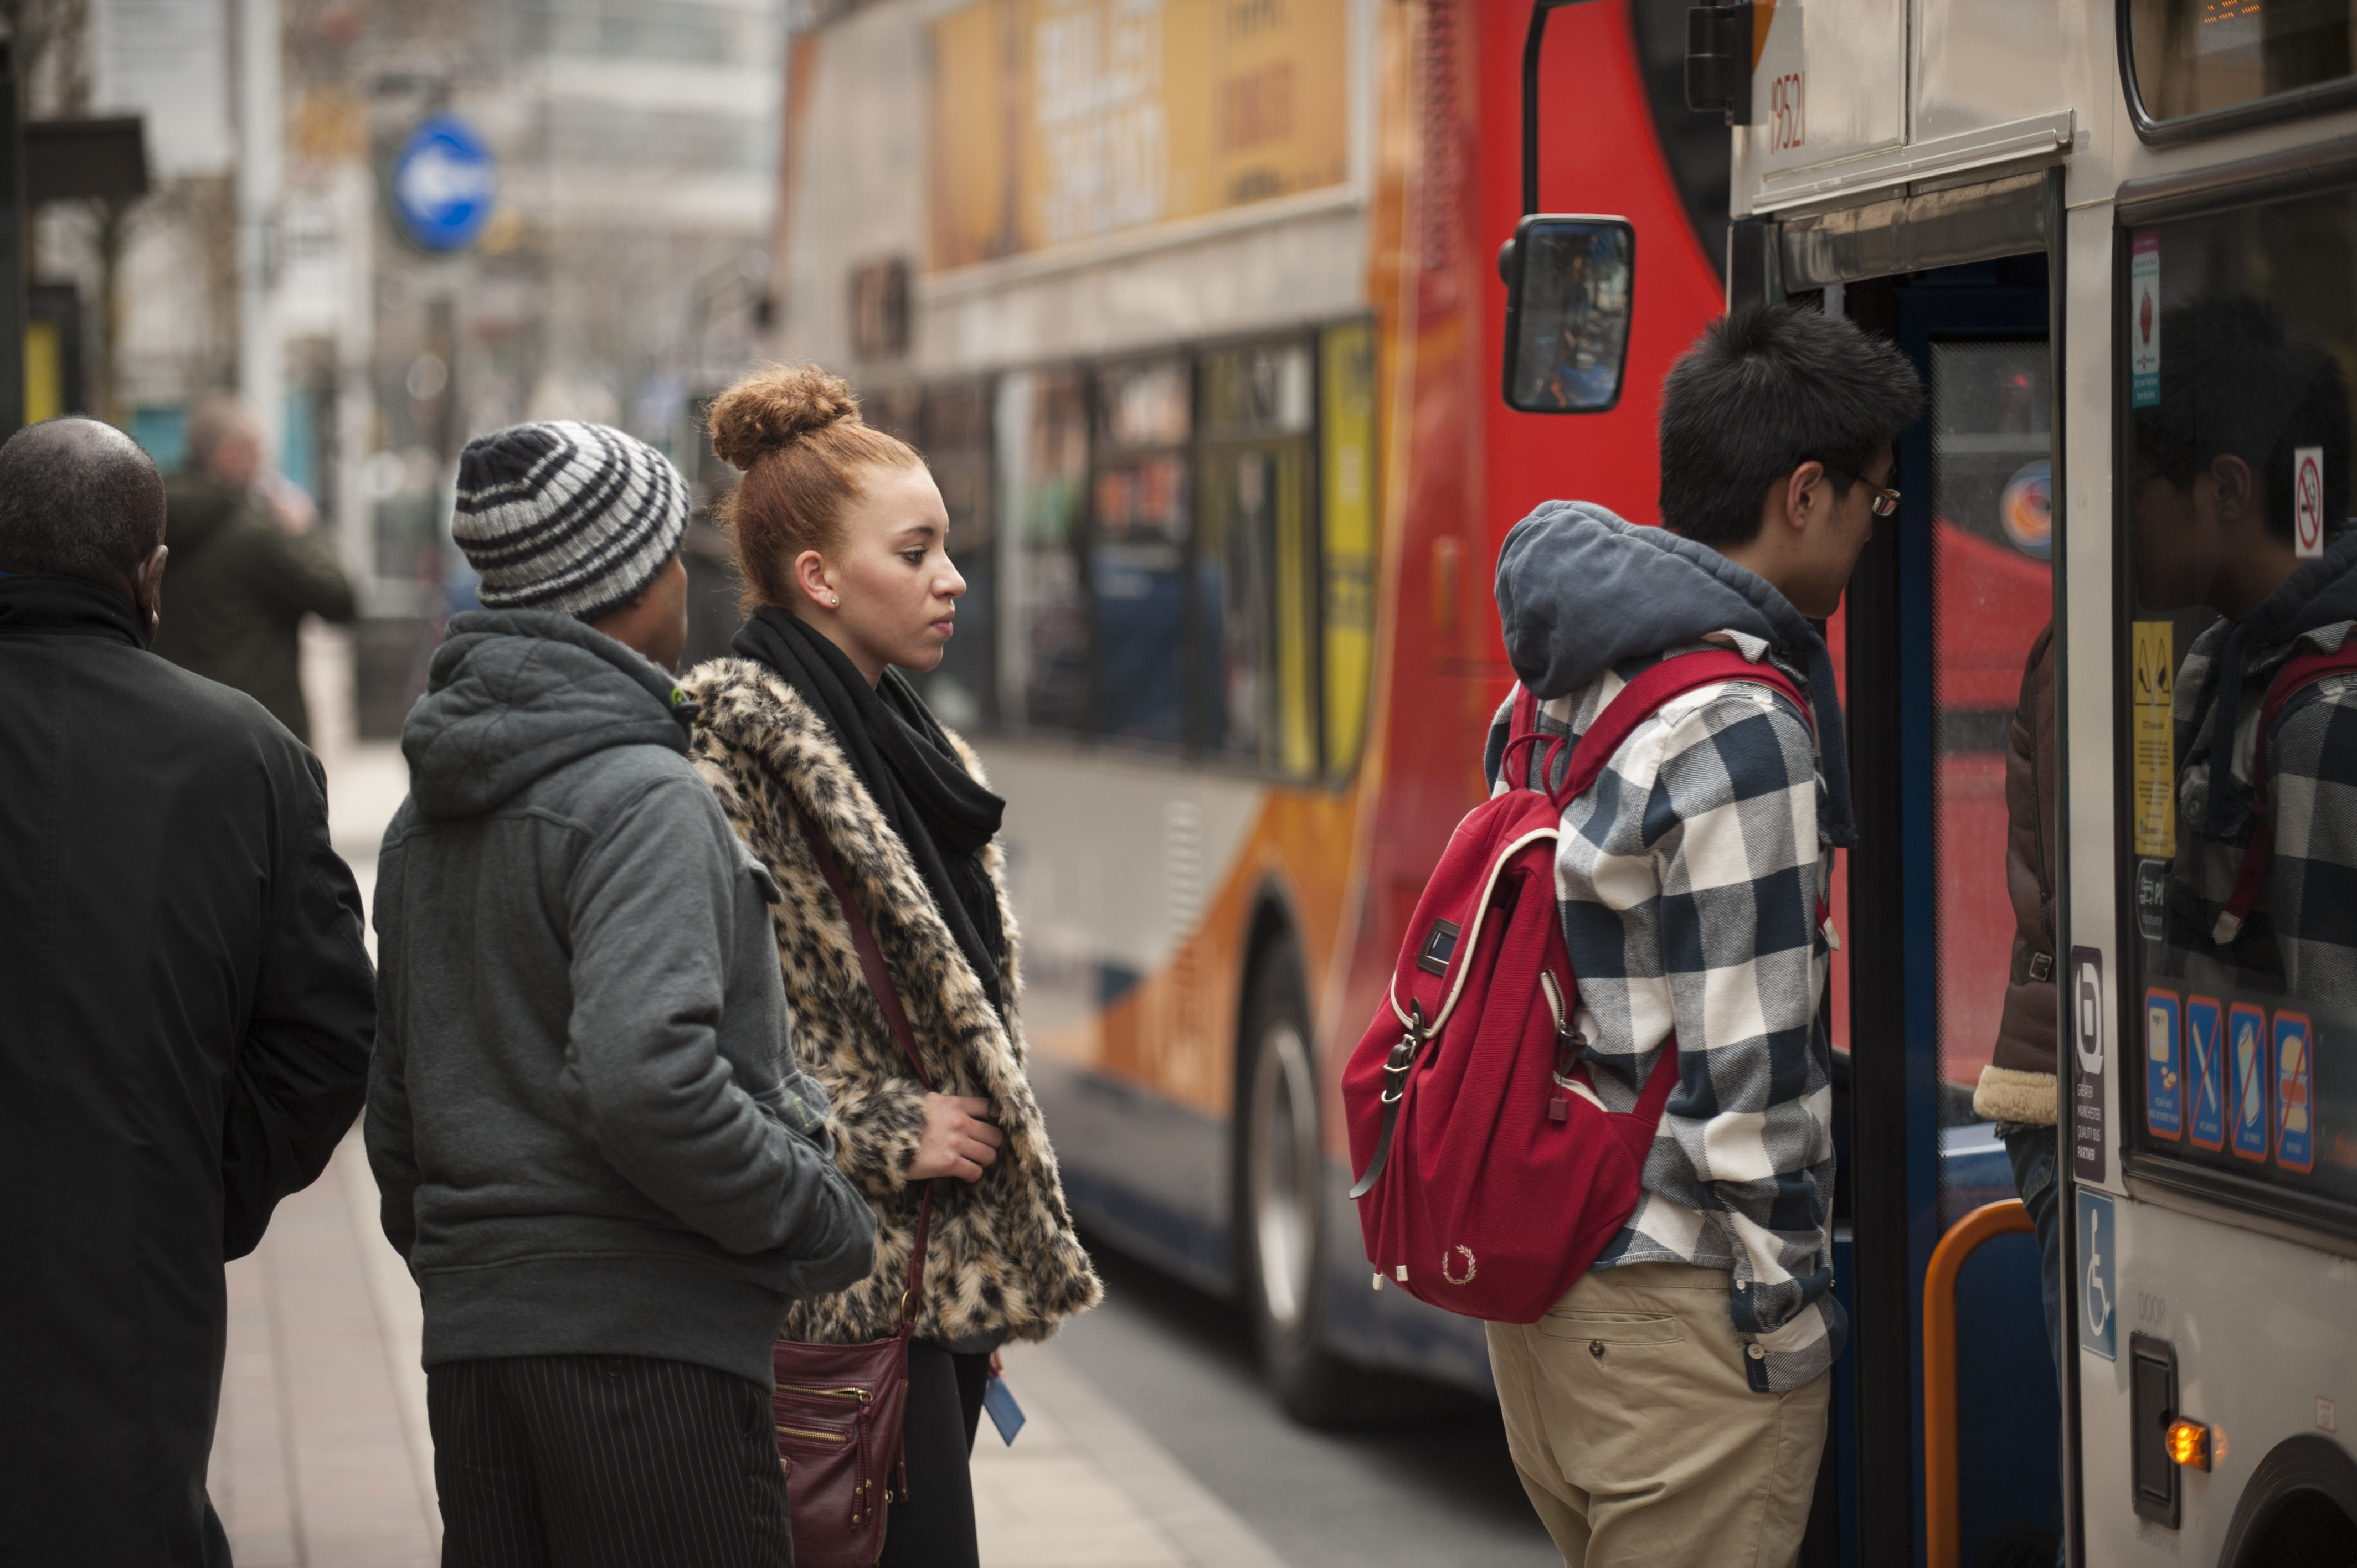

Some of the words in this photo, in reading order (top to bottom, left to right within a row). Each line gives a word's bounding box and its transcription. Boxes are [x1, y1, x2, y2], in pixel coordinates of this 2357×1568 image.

[1771, 71, 1806, 155] 19521
[2078, 1084, 2093, 1098] GREATER
[2078, 1105, 2101, 1121] MANCHESTER
[2078, 1125, 2093, 1141] QUALITY
[2200, 1121, 2204, 1130] NO
[2205, 1122, 2218, 1134] SMOKING
[2078, 1145, 2096, 1162] PARTNER
[2287, 1142, 2292, 1152] NO
[2292, 1143, 2301, 1154] FOOD
[2138, 1291, 2166, 1327] DOOR
